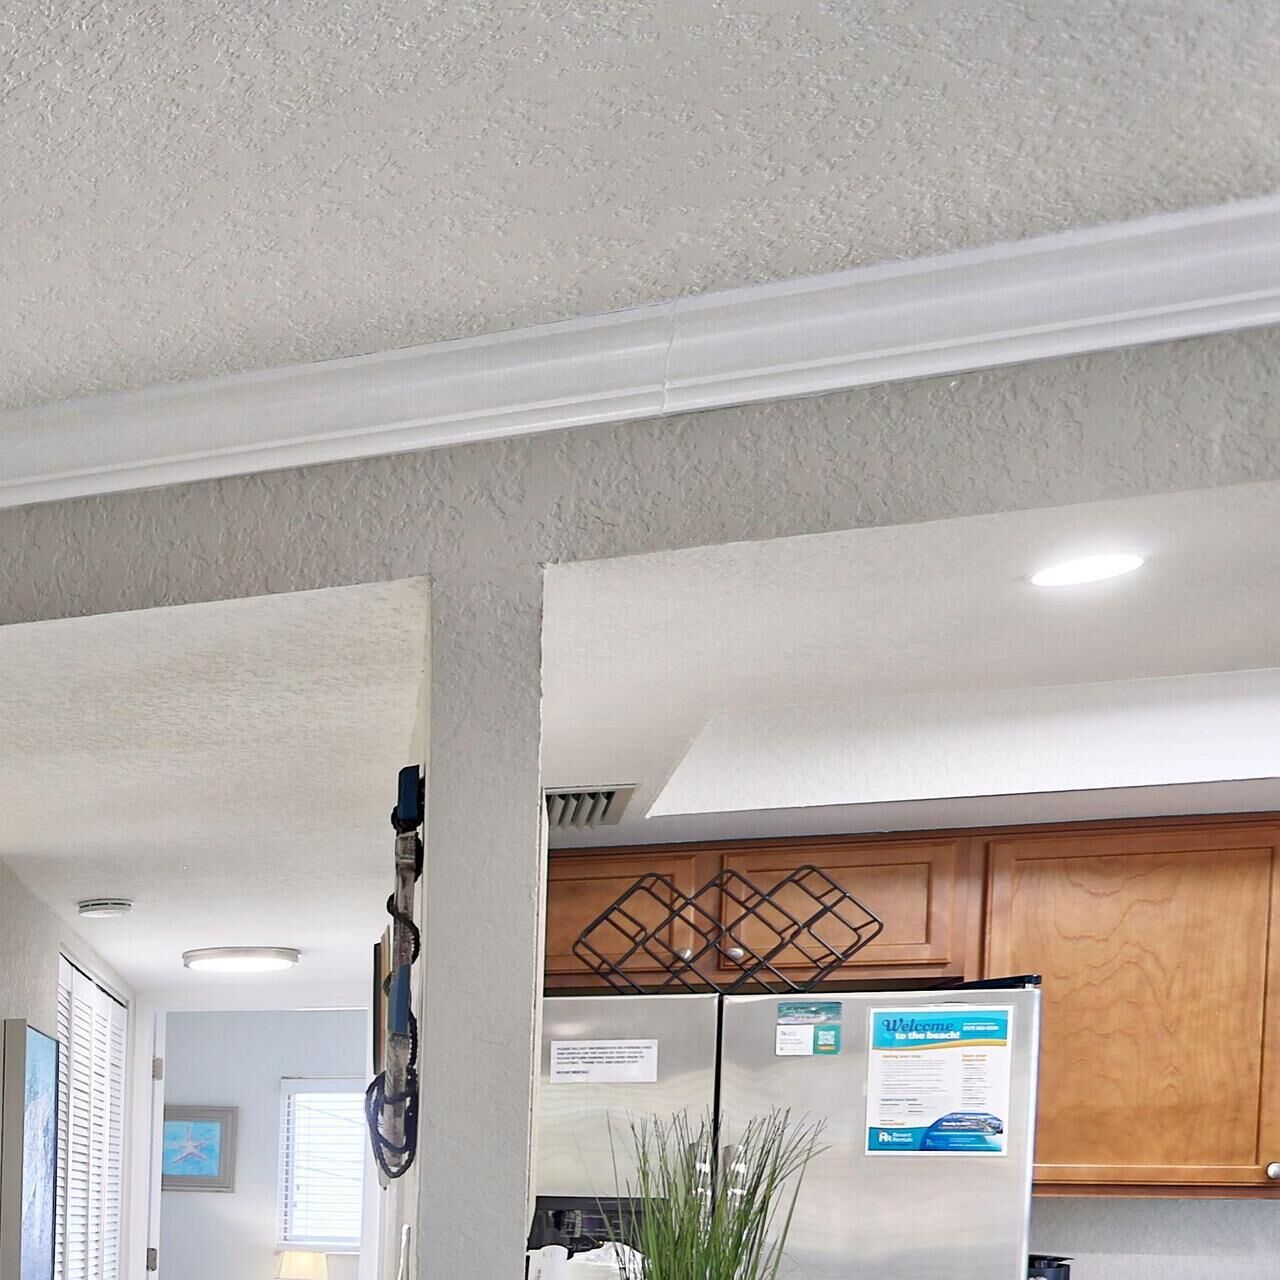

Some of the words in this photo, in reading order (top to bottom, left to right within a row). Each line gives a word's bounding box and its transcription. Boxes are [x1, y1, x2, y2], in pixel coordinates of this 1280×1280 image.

[881, 1018, 954, 1032] Welcome
[895, 1032, 906, 1040] to
[907, 1032, 925, 1040] the
[926, 1031, 960, 1039] beach!
